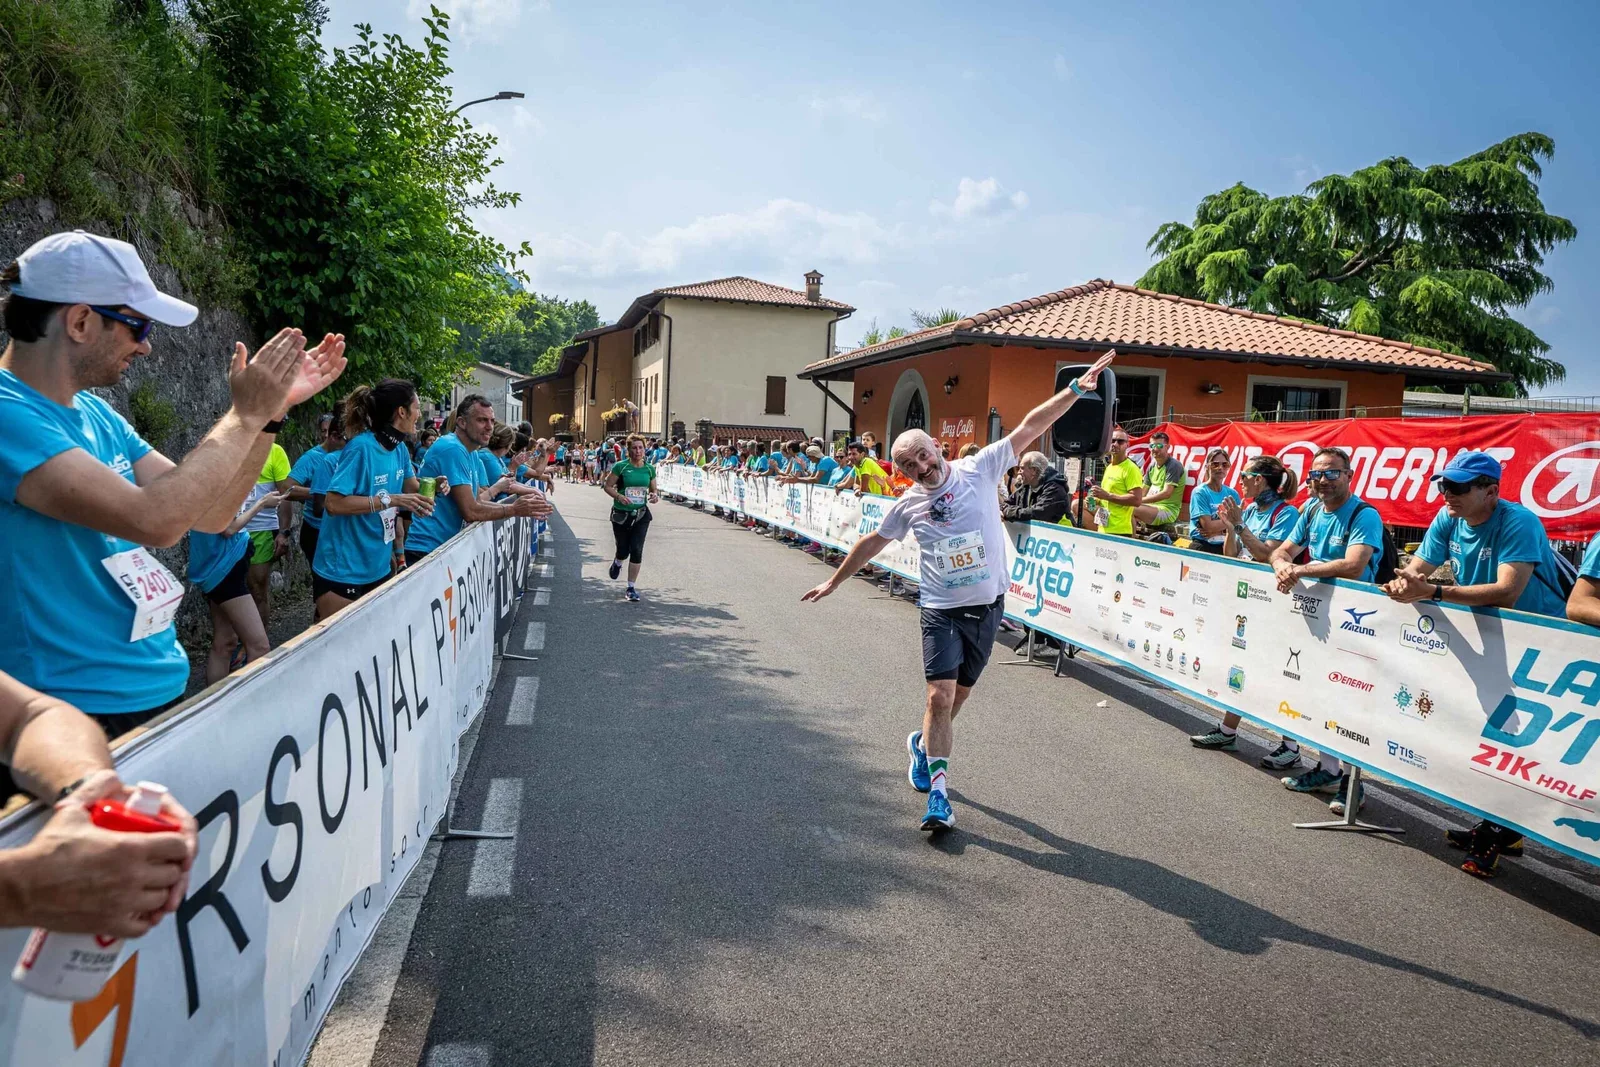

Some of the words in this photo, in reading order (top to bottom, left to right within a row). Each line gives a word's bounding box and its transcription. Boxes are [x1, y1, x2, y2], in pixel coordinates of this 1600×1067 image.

[1016, 533, 1061, 563] LAGO
[949, 552, 973, 569] 183
[1009, 583, 1024, 596] 21K
[1044, 599, 1072, 614] MARATHON
[1247, 593, 1272, 603] Lombardia
[1248, 585, 1268, 595] Regione
[1293, 602, 1317, 614] LAND
[1403, 629, 1446, 650] luce&gas
[1341, 675, 1375, 693] ENERVIT
[1399, 746, 1414, 760] TIS
[1471, 743, 1541, 782] 21K
[1536, 773, 1597, 800] HALF
